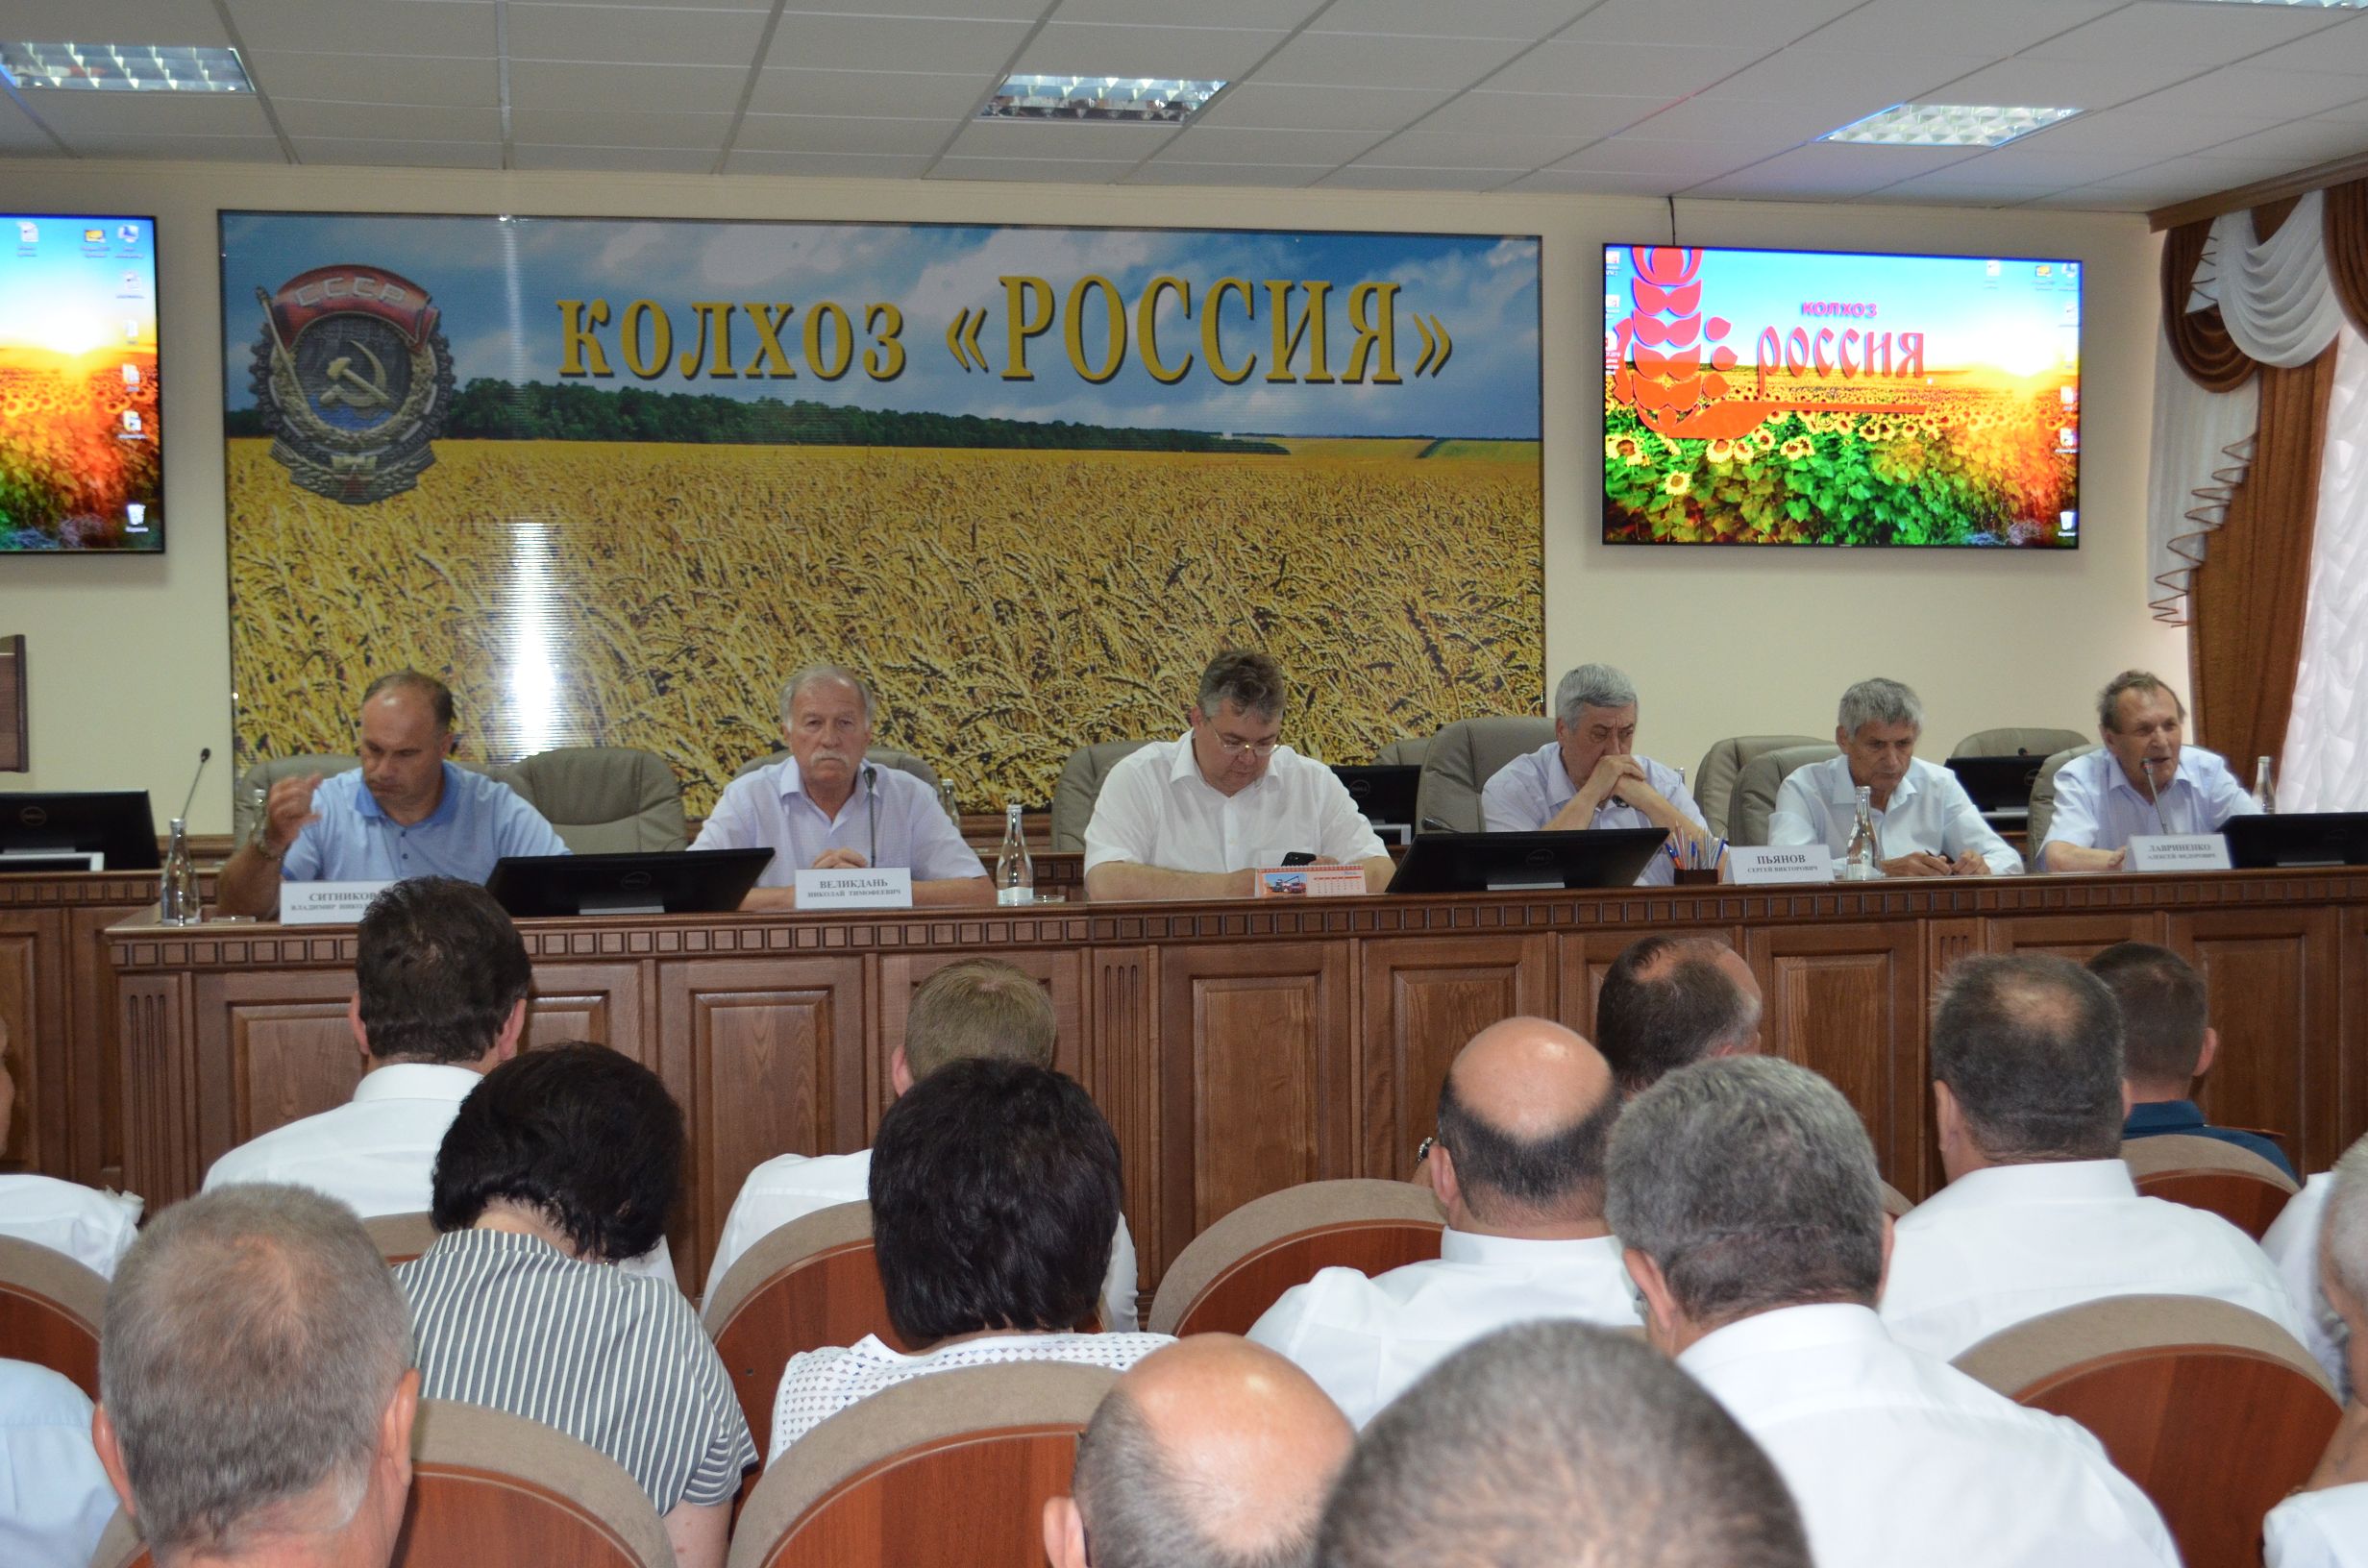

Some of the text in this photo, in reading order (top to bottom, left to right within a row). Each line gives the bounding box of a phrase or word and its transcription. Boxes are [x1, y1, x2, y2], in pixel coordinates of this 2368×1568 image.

[294, 277, 406, 307] СССР
[946, 274, 1454, 384] «РОССИЯ»
[1757, 854, 1806, 865] ПЬЯНОВ
[820, 879, 888, 889] ВЕЛИКДАНЬ
